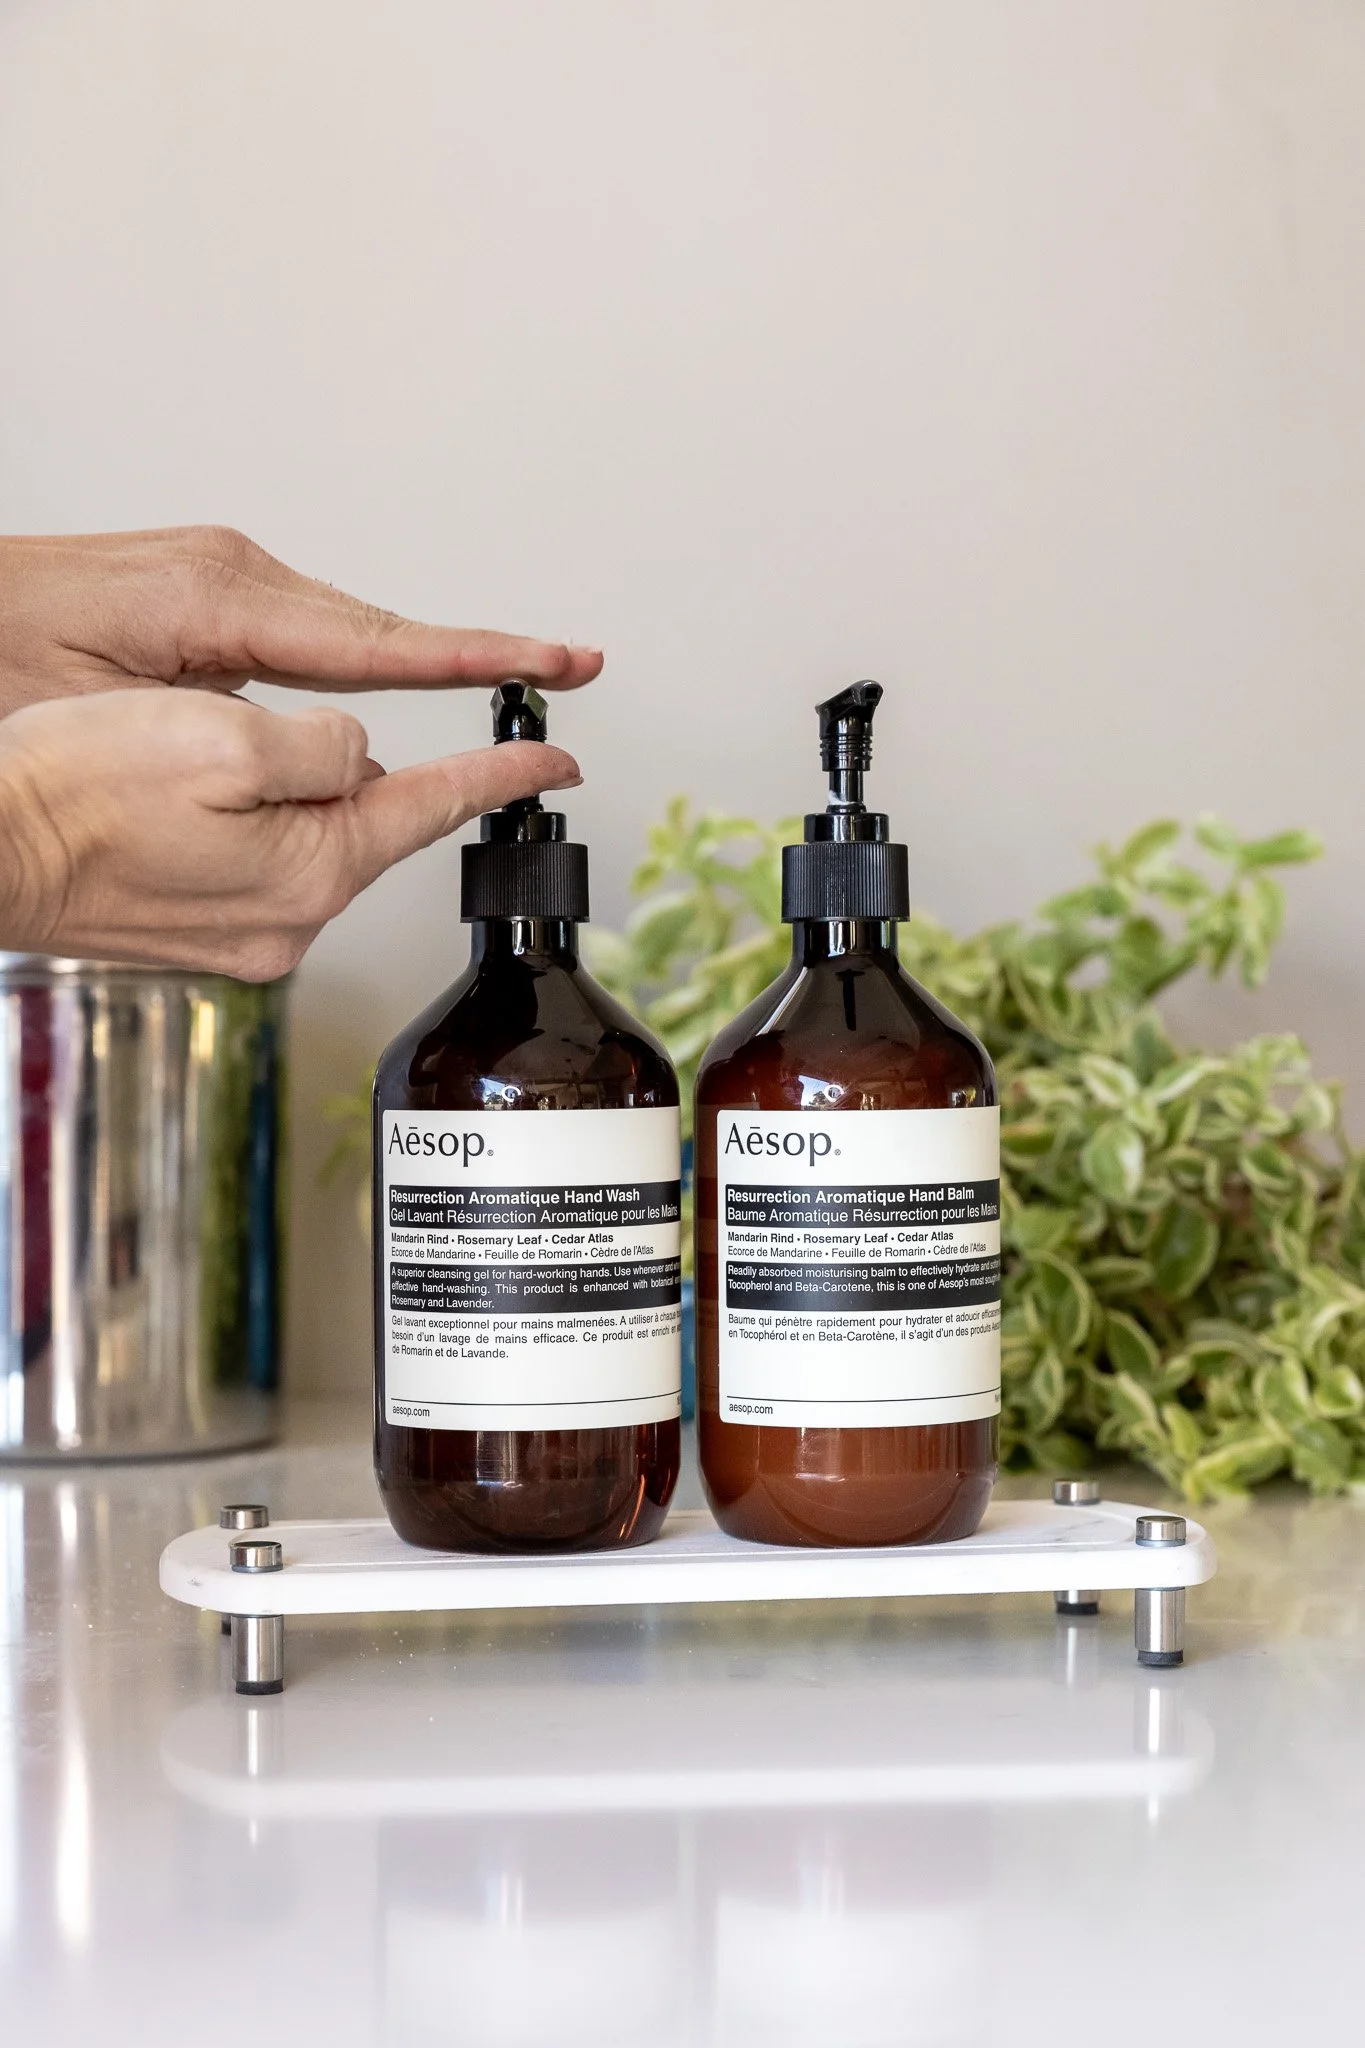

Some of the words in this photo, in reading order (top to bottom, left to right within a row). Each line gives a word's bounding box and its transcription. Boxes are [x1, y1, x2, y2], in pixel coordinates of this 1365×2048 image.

[391, 1189, 464, 1204] Resurrection
[469, 1191, 560, 1207] Aromatique
[565, 1190, 602, 1203] Hand
[606, 1188, 640, 1202] Wash
[728, 1189, 811, 1204] Resurrection
[815, 1190, 905, 1206] Aromatique
[910, 1188, 944, 1202] Hand
[948, 1187, 974, 1200] Balm
[391, 1208, 405, 1221] Gel
[408, 1209, 444, 1223] Lavant
[447, 1210, 536, 1223] Résurrection
[540, 1209, 618, 1224] Aromatique
[621, 1209, 646, 1223] pour
[728, 1207, 766, 1221] Baume
[769, 1208, 848, 1226] Aromatique
[853, 1207, 938, 1222] Résurrection
[941, 1208, 965, 1222] pour
[967, 1205, 979, 1217] les
[391, 1232, 425, 1244] Mandarin
[427, 1234, 449, 1244] Rind
[457, 1235, 514, 1247] Rosemary
[517, 1234, 542, 1245] Leaf
[552, 1234, 585, 1244] Cedar
[588, 1233, 614, 1243] Atlas
[728, 1231, 768, 1242] Mandarin
[771, 1233, 794, 1243] Rind
[804, 1234, 861, 1246] Rosemary
[864, 1233, 888, 1243] Leaf
[897, 1232, 928, 1242] Cedar
[931, 1231, 954, 1241] Atlas
[391, 1246, 413, 1258] Ecorce
[414, 1248, 425, 1258] de
[427, 1248, 476, 1259] Mandarine
[485, 1249, 519, 1260] Feuille
[521, 1249, 536, 1260] de
[538, 1248, 582, 1259] Romarin
[590, 1247, 619, 1258] Cèdre
[621, 1246, 632, 1256] de
[633, 1245, 654, 1255] l'Atlas
[728, 1245, 755, 1257] Ecorce
[756, 1247, 768, 1257] de
[770, 1247, 822, 1258] Mandarine
[832, 1248, 866, 1258] Feuille
[868, 1248, 882, 1258] de
[885, 1246, 926, 1257] Romarin
[933, 1245, 958, 1255] Cèdre
[959, 1244, 969, 1254] de
[391, 1266, 396, 1276] A
[397, 1268, 426, 1279] superior
[427, 1268, 471, 1282] cleansing
[474, 1269, 489, 1282] gel
[492, 1269, 506, 1279] for
[508, 1269, 577, 1281] hard-working
[580, 1267, 612, 1278] hands.
[614, 1266, 631, 1276] Use
[633, 1265, 664, 1275] whenever
[728, 1265, 757, 1278] Readily
[758, 1267, 803, 1278] absorbed
[805, 1267, 868, 1280] moisturising
[871, 1267, 896, 1277] balm
[898, 1267, 908, 1276] to
[910, 1264, 954, 1276] effectively
[955, 1263, 980, 1275] hydrate
[392, 1281, 419, 1292] effective
[422, 1282, 491, 1297] hand-washing.
[495, 1284, 518, 1294] This
[523, 1283, 564, 1296] product
[569, 1283, 578, 1293] is
[583, 1280, 629, 1292] enhanced
[633, 1279, 648, 1289] with
[728, 1279, 772, 1292] Tocopherol
[774, 1282, 792, 1291] and
[795, 1281, 873, 1292] Beta-Carotene,
[876, 1281, 895, 1291] this
[897, 1281, 906, 1291] is
[908, 1282, 926, 1290] one
[928, 1279, 937, 1289] of
[938, 1277, 969, 1290] Aesop's
[392, 1294, 426, 1309] Rosemary
[427, 1297, 444, 1307] and
[446, 1298, 495, 1309] Lavender.
[392, 1315, 402, 1326] Gel
[404, 1317, 426, 1327] lavant
[428, 1319, 489, 1331] exceptionnel
[493, 1321, 518, 1332] pour
[521, 1319, 554, 1329] mains
[557, 1316, 618, 1328] malmenées.
[619, 1316, 627, 1325] A
[629, 1314, 653, 1325] utiliser
[728, 1313, 756, 1325] Baume
[758, 1316, 772, 1327] qui
[775, 1316, 812, 1328] pénètre
[816, 1317, 876, 1329] rapidement
[879, 1318, 902, 1329] pour
[906, 1315, 943, 1328] hydrater
[945, 1314, 953, 1323] et
[955, 1312, 980, 1323] adoucir
[392, 1330, 414, 1341] besoin
[417, 1332, 435, 1342] d'un
[439, 1333, 470, 1346] lavage
[476, 1334, 489, 1344] de
[495, 1334, 528, 1344] mains
[533, 1333, 578, 1344] efficace.
[583, 1332, 597, 1342] Ce
[602, 1329, 633, 1343] produit
[637, 1329, 649, 1339] est
[739, 1328, 787, 1342] Tocophérol
[790, 1332, 799, 1341] et
[819, 1331, 898, 1341] Beta-Carotène,
[901, 1330, 906, 1340] il
[909, 1329, 934, 1341] s'agit
[936, 1328, 954, 1338] d'un
[955, 1327, 969, 1337] des
[392, 1344, 400, 1354] de
[401, 1344, 433, 1356] Romarin
[435, 1348, 444, 1357] et
[446, 1347, 458, 1358] de
[461, 1348, 508, 1358] Lavande.
[392, 1406, 430, 1417] aesop.com
[729, 1403, 773, 1415] aesop.com
